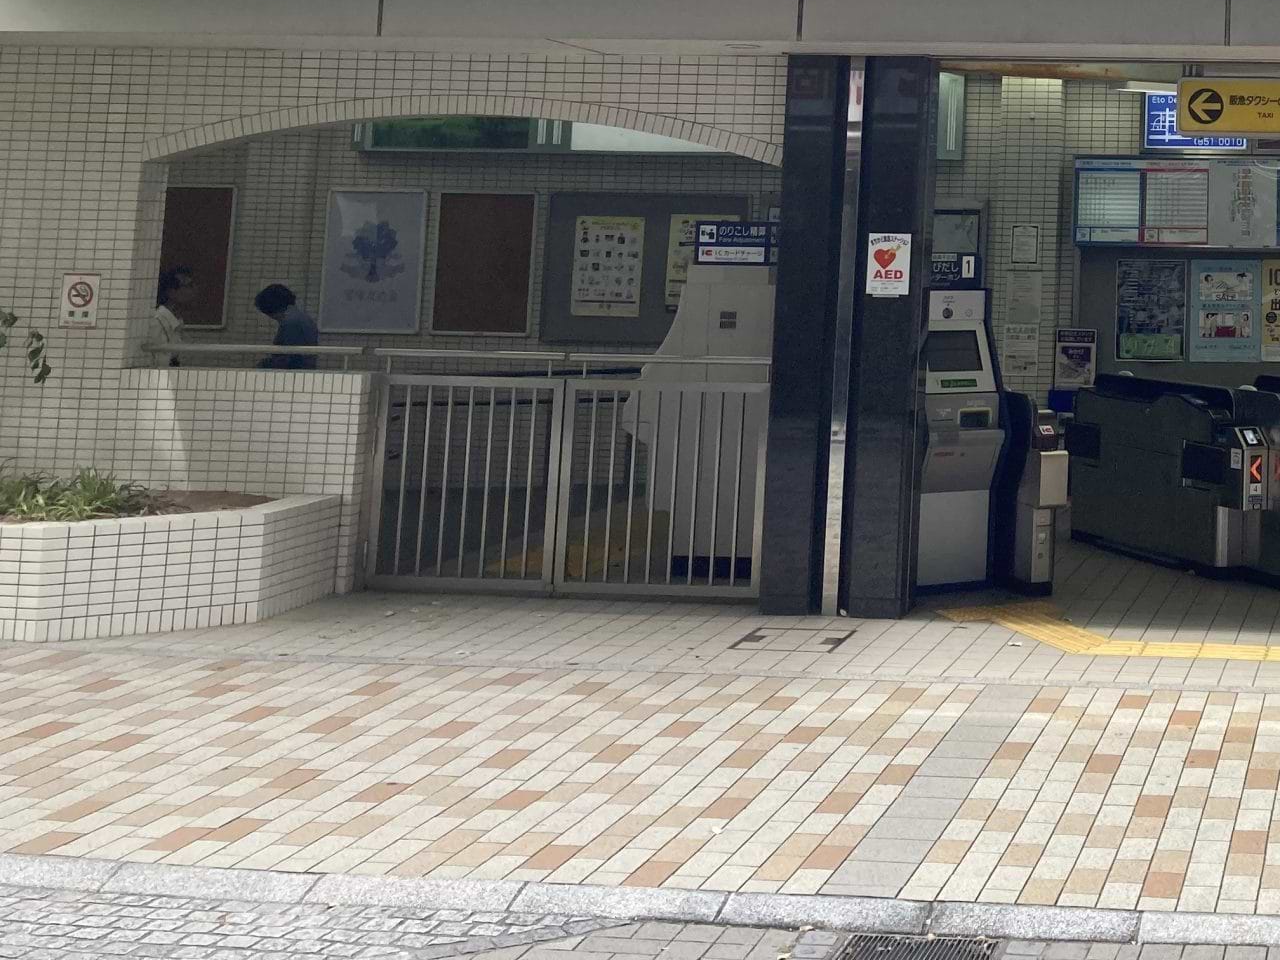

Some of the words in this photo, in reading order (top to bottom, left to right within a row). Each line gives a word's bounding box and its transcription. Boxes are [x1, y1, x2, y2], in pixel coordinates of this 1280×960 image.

[719, 226, 766, 237] のりこし精算
[966, 259, 971, 274] 1
[873, 269, 904, 280] AED
